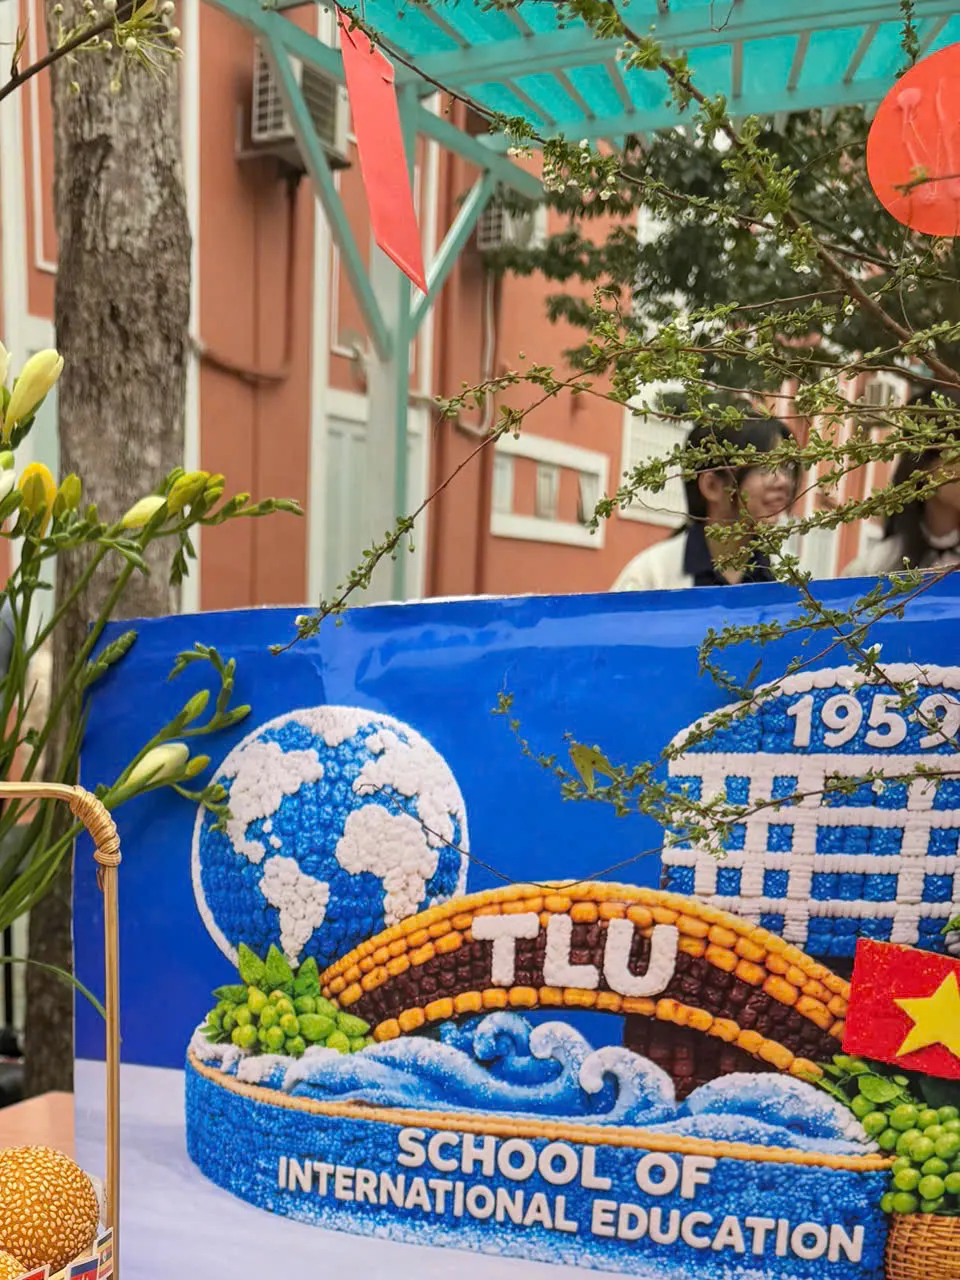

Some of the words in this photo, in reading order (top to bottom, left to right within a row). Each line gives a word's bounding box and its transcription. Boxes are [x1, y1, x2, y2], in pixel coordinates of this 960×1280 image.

[786, 693, 960, 749] 1959
[471, 911, 680, 998] TLU
[397, 1127, 612, 1191] SCHOOL
[636, 1152, 717, 1199] OF
[278, 1156, 579, 1233] INTERNATIONAL
[591, 1199, 866, 1264] EDUCATION
